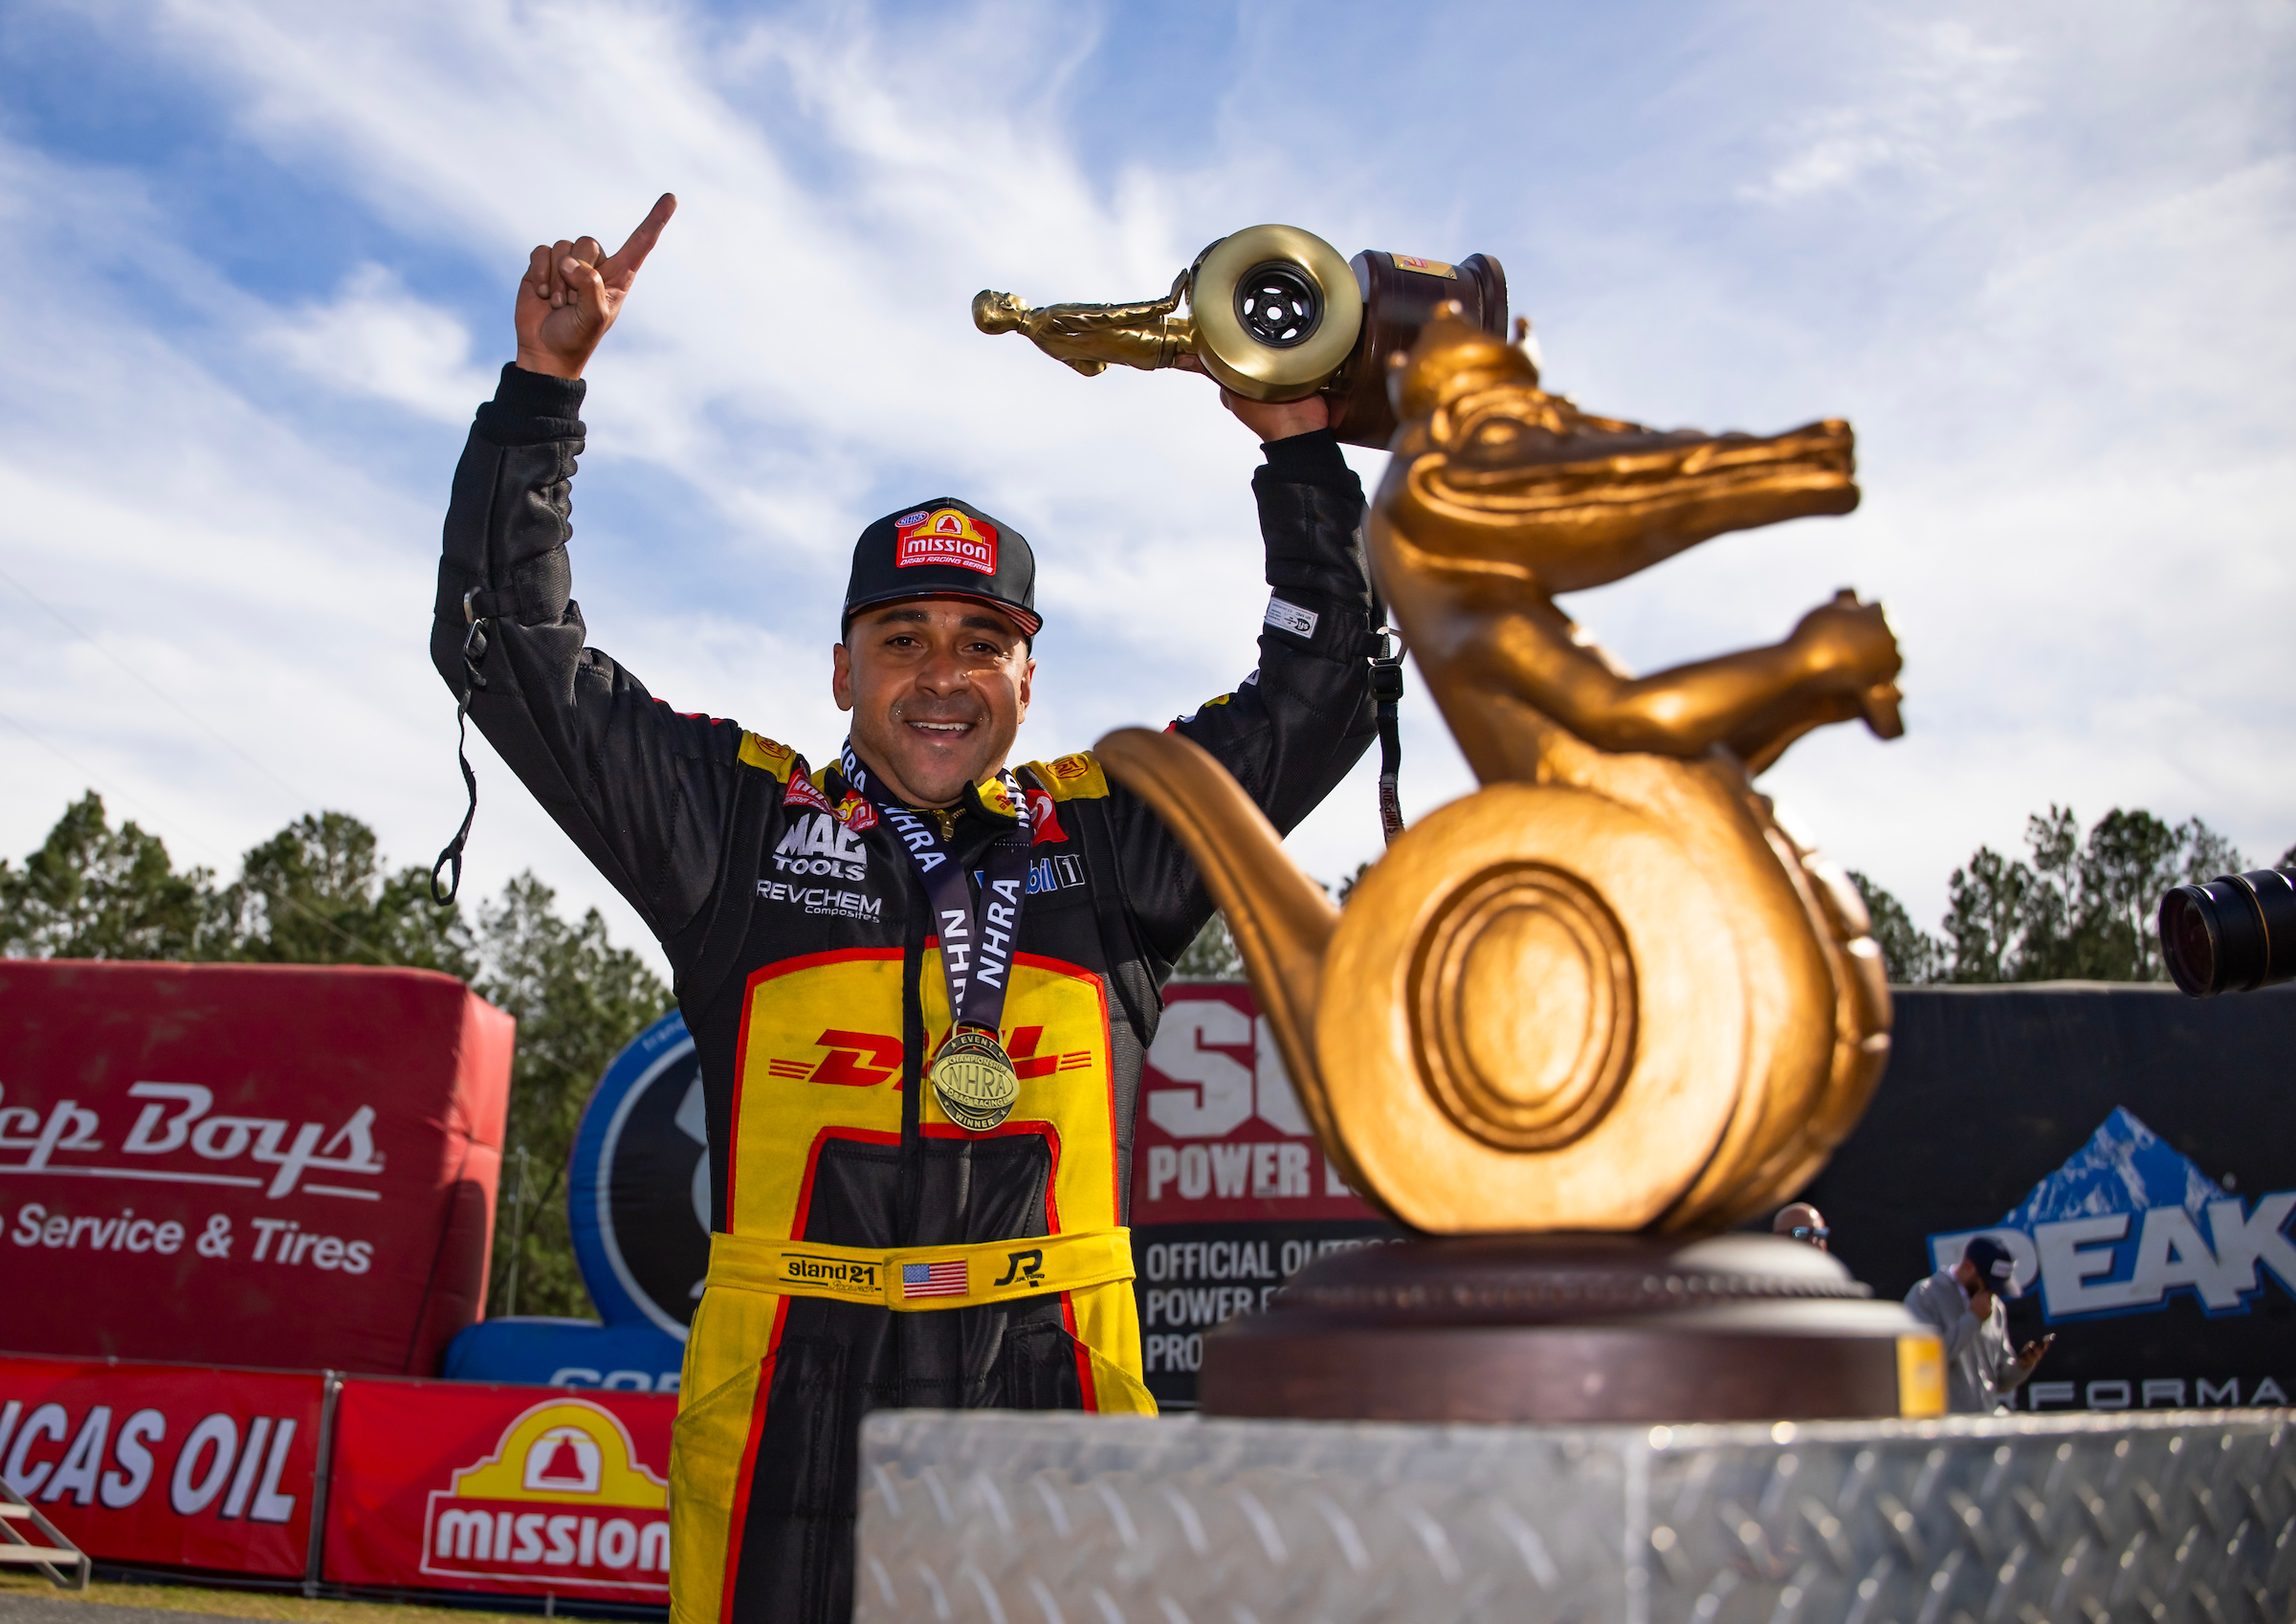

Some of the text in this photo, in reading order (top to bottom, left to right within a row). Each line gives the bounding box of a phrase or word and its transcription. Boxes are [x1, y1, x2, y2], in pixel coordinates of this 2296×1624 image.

[926, 556, 962, 564] RACING
[962, 560, 993, 574] SERIES
[775, 813, 867, 865] MAC
[877, 801, 947, 873] NHRA
[772, 854, 866, 881] TOOLS
[756, 879, 882, 915] REVCHEM
[805, 906, 880, 923] Composites
[977, 880, 1021, 989] NHRA
[808, 1025, 1059, 1090] DL
[960, 1036, 994, 1049] EVENT
[948, 1055, 1007, 1074] CHAMPIONSHIP
[949, 1064, 1005, 1097] NHRA
[947, 1087, 1003, 1108] DRAG RACING
[121, 1081, 384, 1199] Boys
[956, 1112, 995, 1129] WINNER
[1148, 1142, 1311, 1201] POWER
[11, 1202, 186, 1255] Service
[196, 1213, 234, 1259] &
[251, 1217, 375, 1275] Tires
[1146, 1240, 1276, 1282] OFFICIAL
[170, 1413, 298, 1523] OIL
